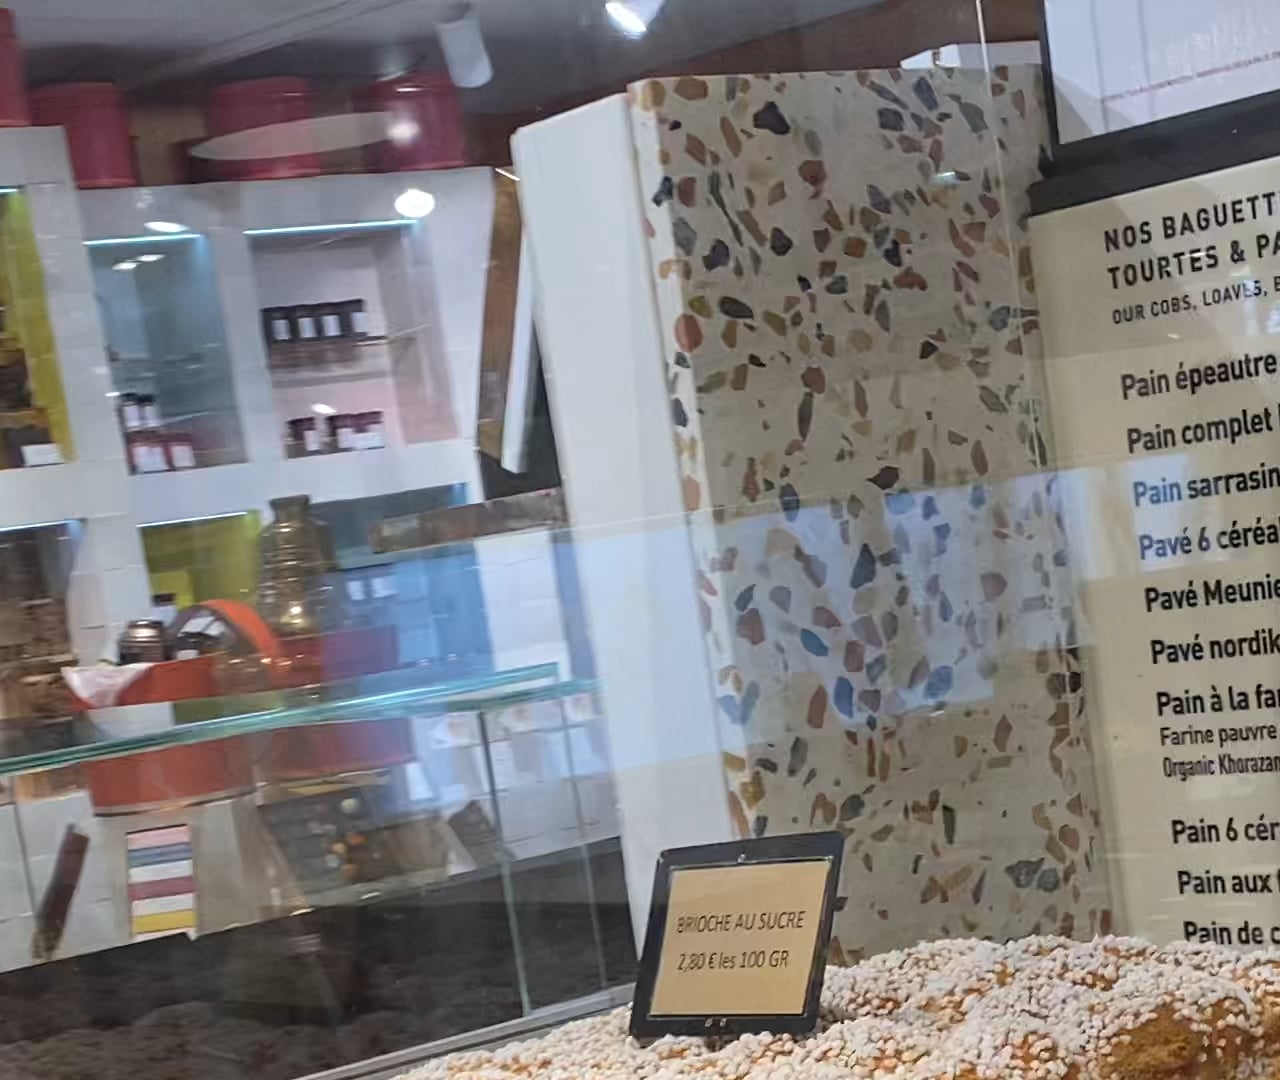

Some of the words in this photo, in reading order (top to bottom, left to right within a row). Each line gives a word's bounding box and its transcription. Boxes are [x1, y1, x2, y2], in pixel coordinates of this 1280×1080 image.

[1104, 221, 1152, 253] NOS
[1107, 245, 1218, 289] TOURTES
[1230, 240, 1246, 264] &
[1112, 304, 1145, 324] OUR
[1151, 295, 1197, 317] COBS,
[1202, 280, 1267, 306] LOAVES,
[1121, 369, 1170, 400] Pain
[1176, 354, 1277, 395] épeautre
[1133, 478, 1182, 506] Pain
[1139, 527, 1192, 560] Pavé
[1197, 527, 1210, 552] 6
[1145, 580, 1198, 612] Pavé
[1157, 690, 1205, 716] Pain
[1210, 685, 1223, 712] à
[1228, 686, 1250, 711] la
[1160, 725, 1214, 746] Farine
[1218, 725, 1277, 748] pauvre
[1163, 755, 1215, 782] Organic
[1172, 818, 1220, 844] Pain
[1226, 817, 1238, 842] 6
[677, 914, 732, 933] BRIOCHE
[734, 913, 756, 930] AU
[758, 911, 806, 930] SUCRE
[1183, 921, 1232, 945] Pain
[1237, 921, 1264, 945] de
[708, 952, 717, 969] €
[719, 952, 736, 969] les
[740, 950, 766, 968] 100
[769, 950, 789, 967] GR
